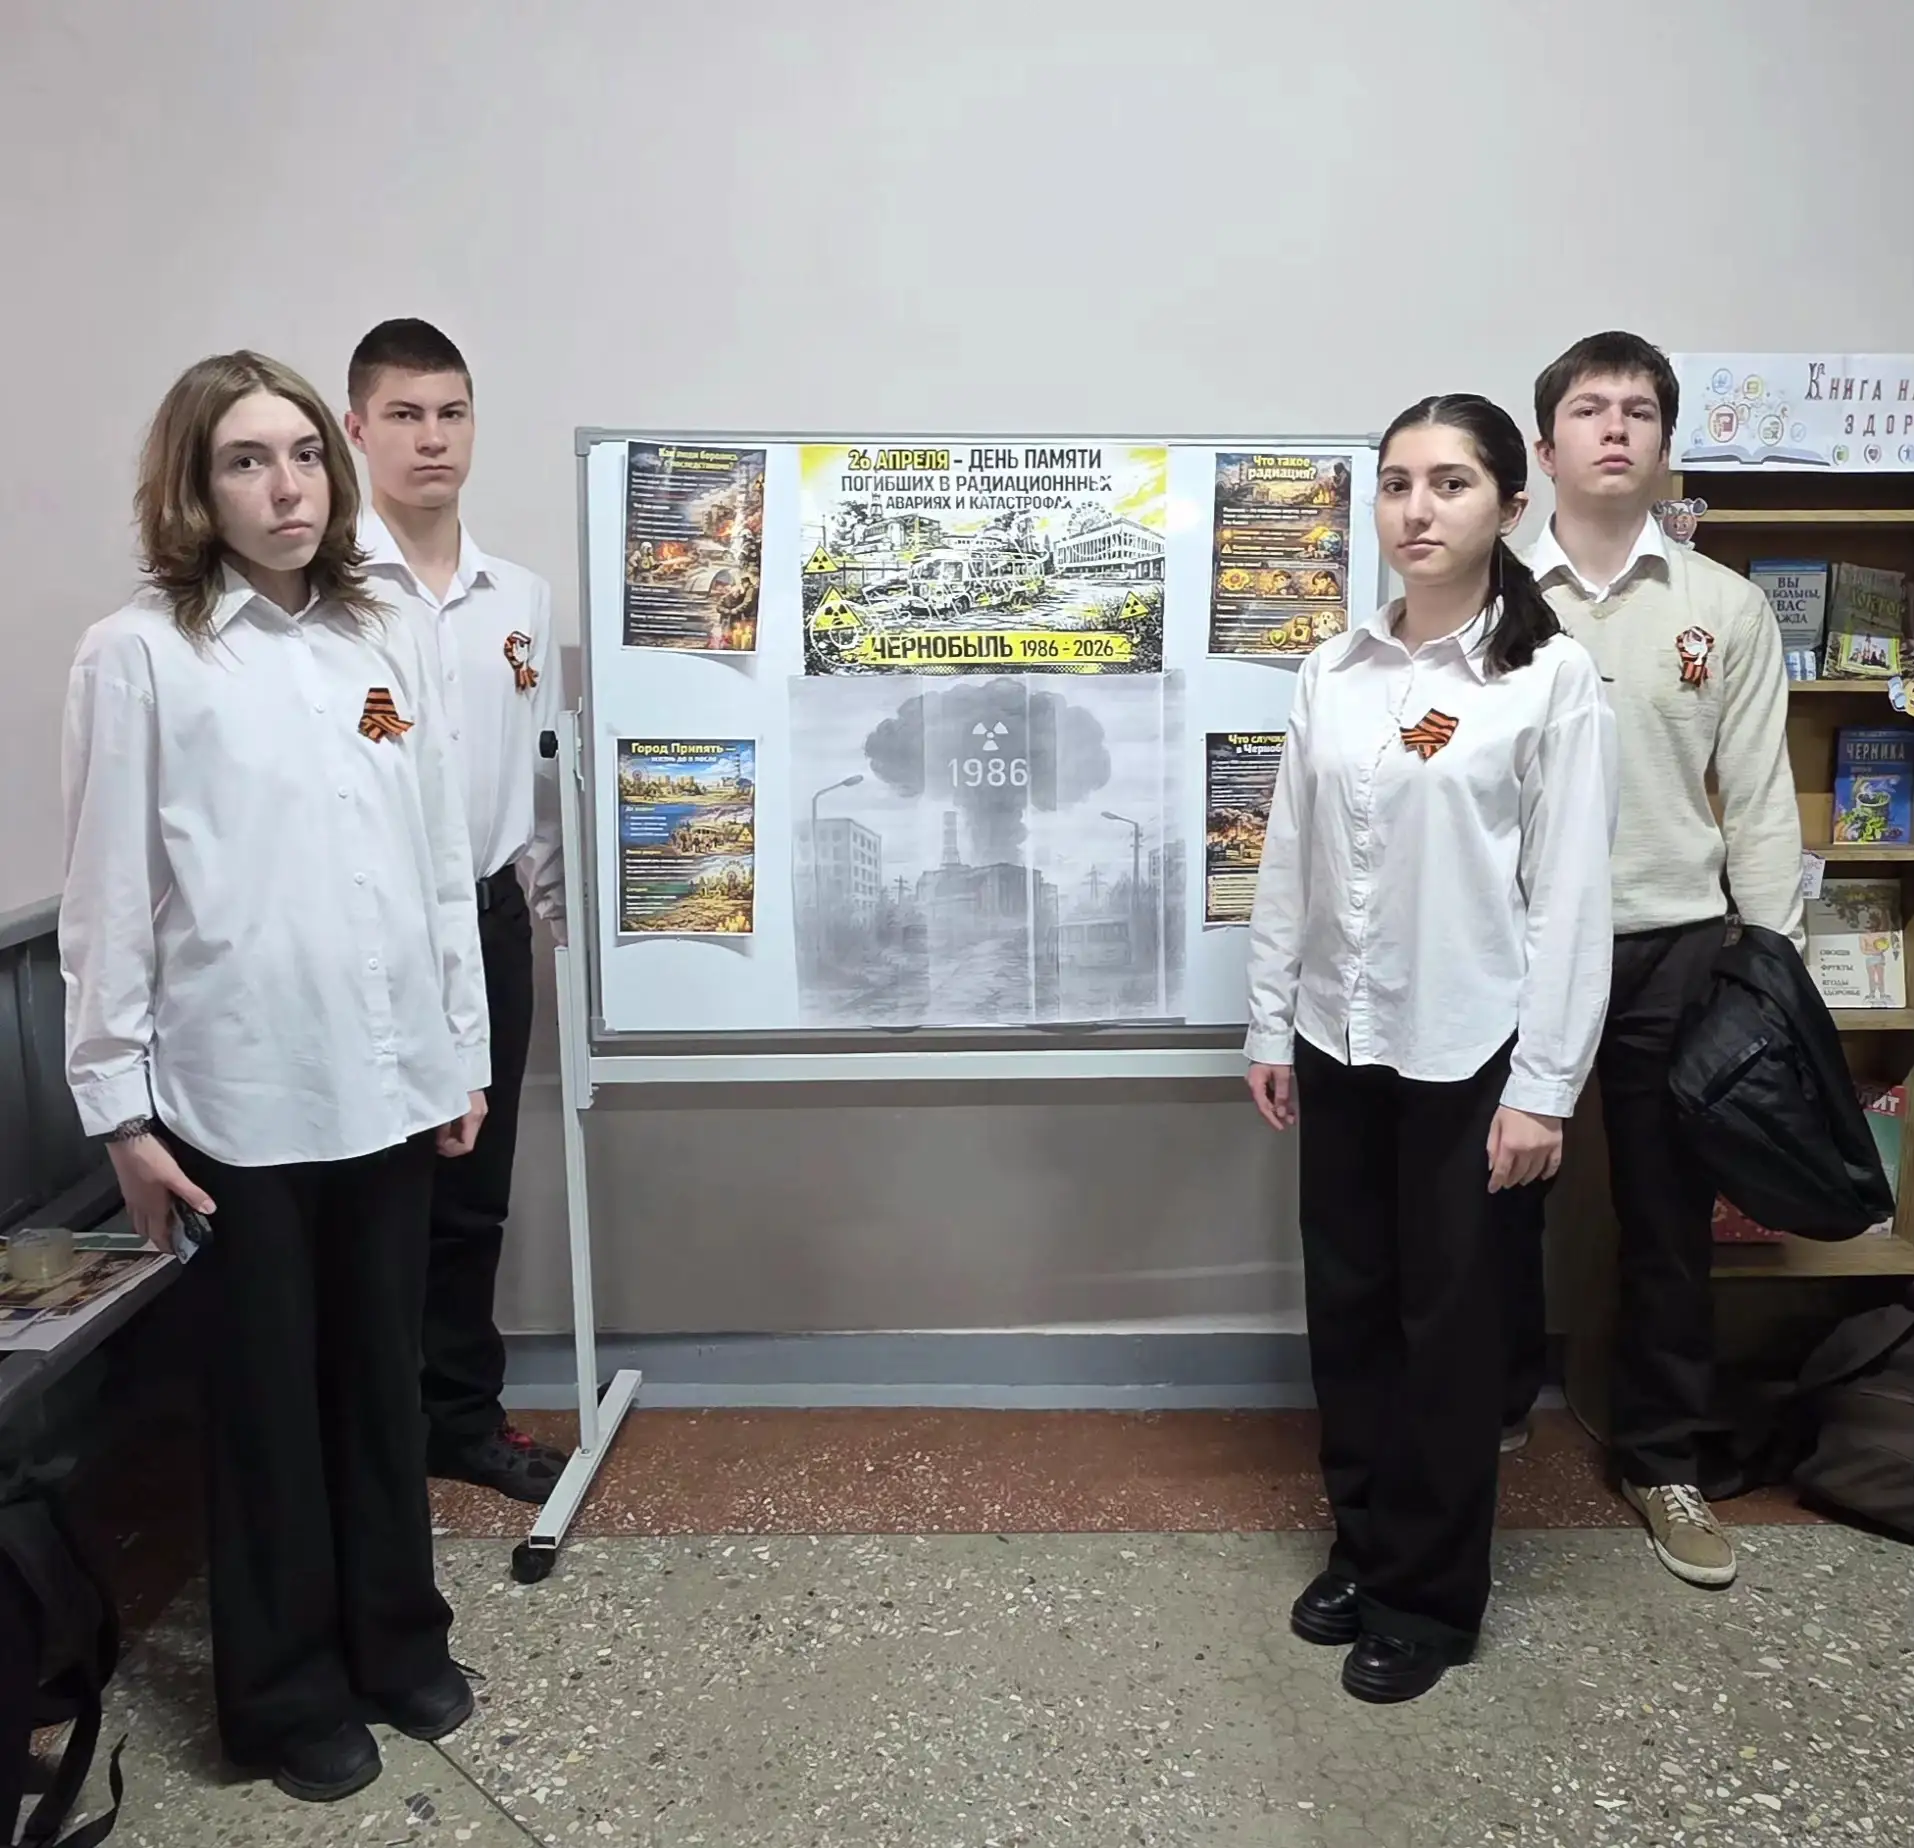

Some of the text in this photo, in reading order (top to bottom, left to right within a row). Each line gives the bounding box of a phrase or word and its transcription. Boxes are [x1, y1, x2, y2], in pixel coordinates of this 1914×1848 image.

[1897, 379, 1914, 401] Н
[1844, 413, 1914, 437] ЗДОР
[848, 449, 872, 471] 26
[873, 449, 950, 471] АПРЕЛЯ
[968, 449, 1018, 472] ДЕНЬ
[1024, 449, 1102, 469] ПАМЯТИ
[1253, 455, 1310, 467] Что такое
[1248, 467, 1317, 480] радиация?
[841, 476, 934, 492] ПОГИБШИХ
[939, 476, 950, 492] В
[886, 496, 1073, 509] АВАРИЯХ И КАТАСТРОФАХ
[1777, 577, 1800, 589] ВЫ
[1776, 600, 1806, 611] ВАС
[871, 636, 1013, 659] ЧЕРНОБЫЛЬ
[1020, 640, 1058, 657] 1986
[1073, 640, 1114, 657] 2026
[1228, 734, 1249, 744] Что
[631, 743, 668, 755] Город
[671, 743, 724, 755] Припять
[1243, 744, 1284, 754] Черноб
[947, 758, 1028, 788] 1986
